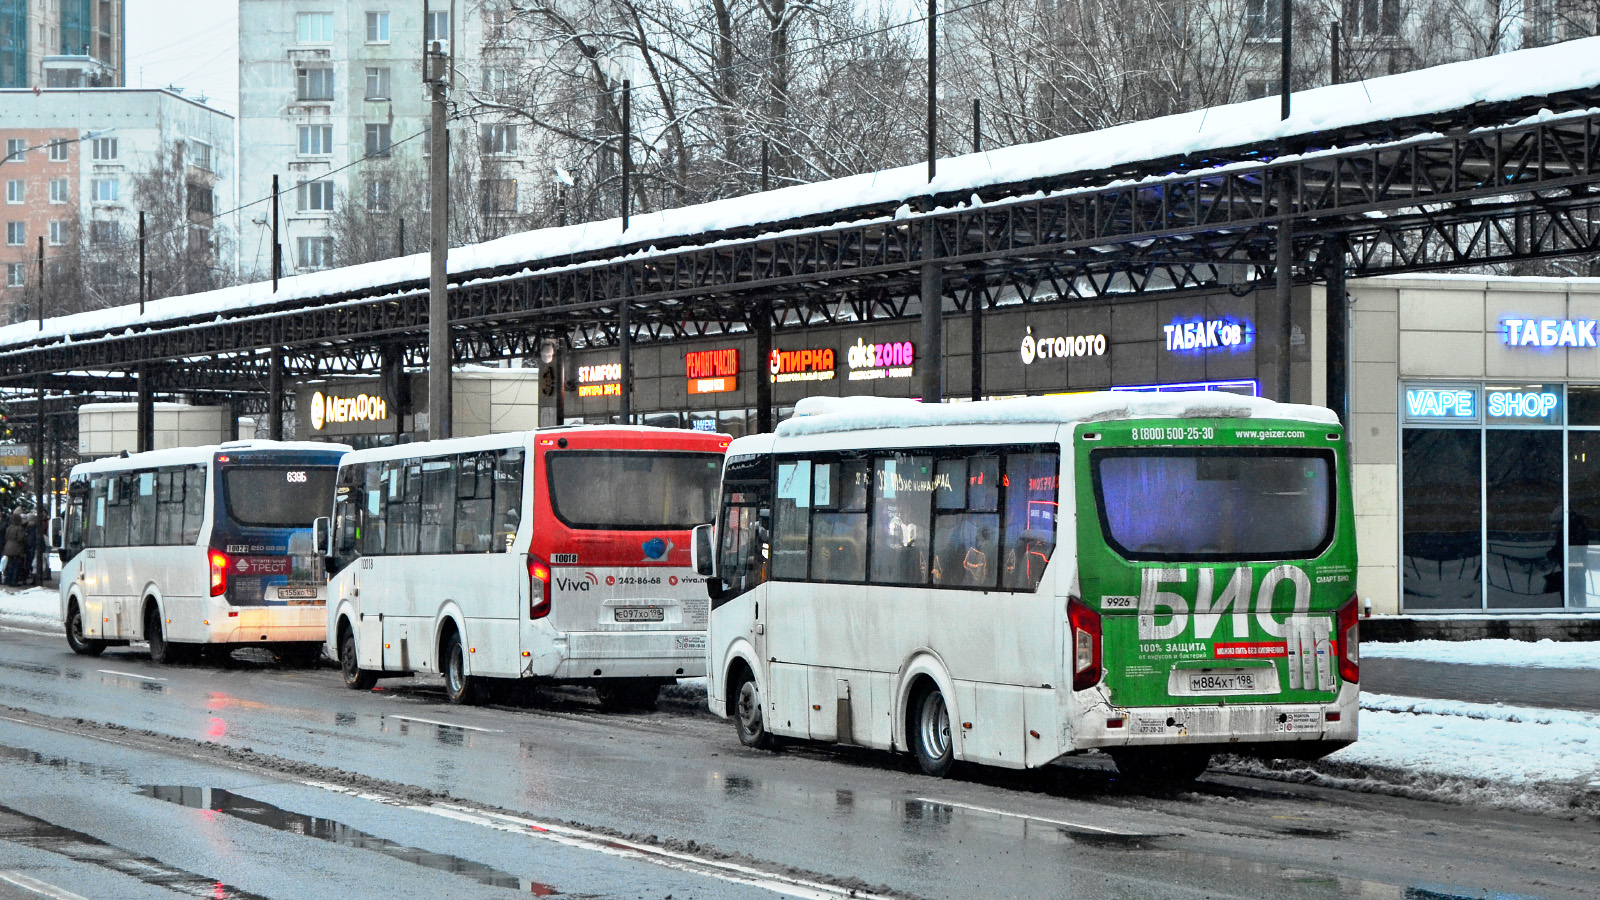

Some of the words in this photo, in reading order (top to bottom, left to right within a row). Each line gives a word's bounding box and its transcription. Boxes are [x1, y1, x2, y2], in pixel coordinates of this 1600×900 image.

[1505, 319, 1597, 347] ТАБАК
[847, 337, 914, 369] akszone
[686, 351, 713, 379] РЕМОНТ
[714, 348, 738, 376] ЧАСОВ
[1406, 390, 1473, 416] VAPE
[1488, 392, 1558, 417] SHOP
[1131, 428, 1139, 440] 8
[1140, 427, 1164, 440] (800)
[1166, 427, 1213, 440] 500-25-30
[1235, 429, 1305, 440] www.geizer.com
[555, 553, 577, 563] 10018
[250, 563, 287, 572] ТРЕСТ
[556, 577, 590, 592] Viva
[618, 577, 661, 585] 242-86-68
[1316, 575, 1337, 583] СМАРТ
[1106, 597, 1131, 607] 9926
[1138, 564, 1312, 641] БИО
[618, 609, 649, 619] Е097ХО
[1138, 644, 1163, 653] 100%
[1165, 642, 1207, 654] ЗАЩИТА
[1216, 648, 1235, 656] МОЖНО
[1247, 647, 1258, 655] БЕЗ
[1147, 654, 1172, 662] вирусов
[1179, 652, 1207, 660] бактерий
[1192, 677, 1235, 689] М884ХТ
[1236, 675, 1251, 686] 198
